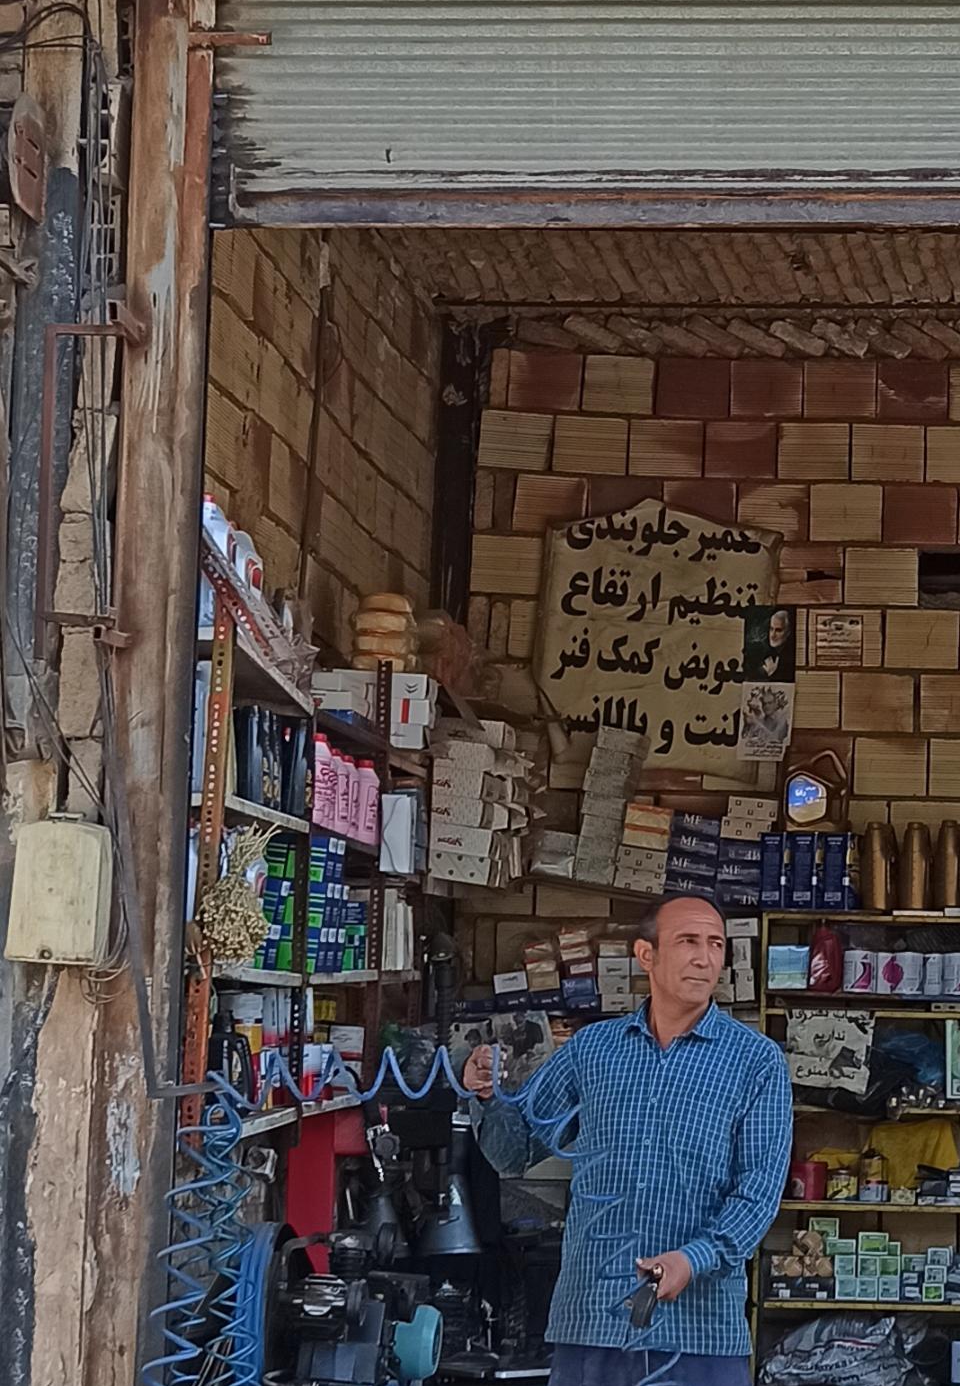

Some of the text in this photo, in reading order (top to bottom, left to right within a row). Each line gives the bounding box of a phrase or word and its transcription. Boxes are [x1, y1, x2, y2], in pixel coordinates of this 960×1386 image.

[566, 509, 690, 560] جلوبندی
[561, 567, 662, 622] ارتفاع
[550, 627, 590, 680] فنر
[596, 635, 661, 675] کمک
